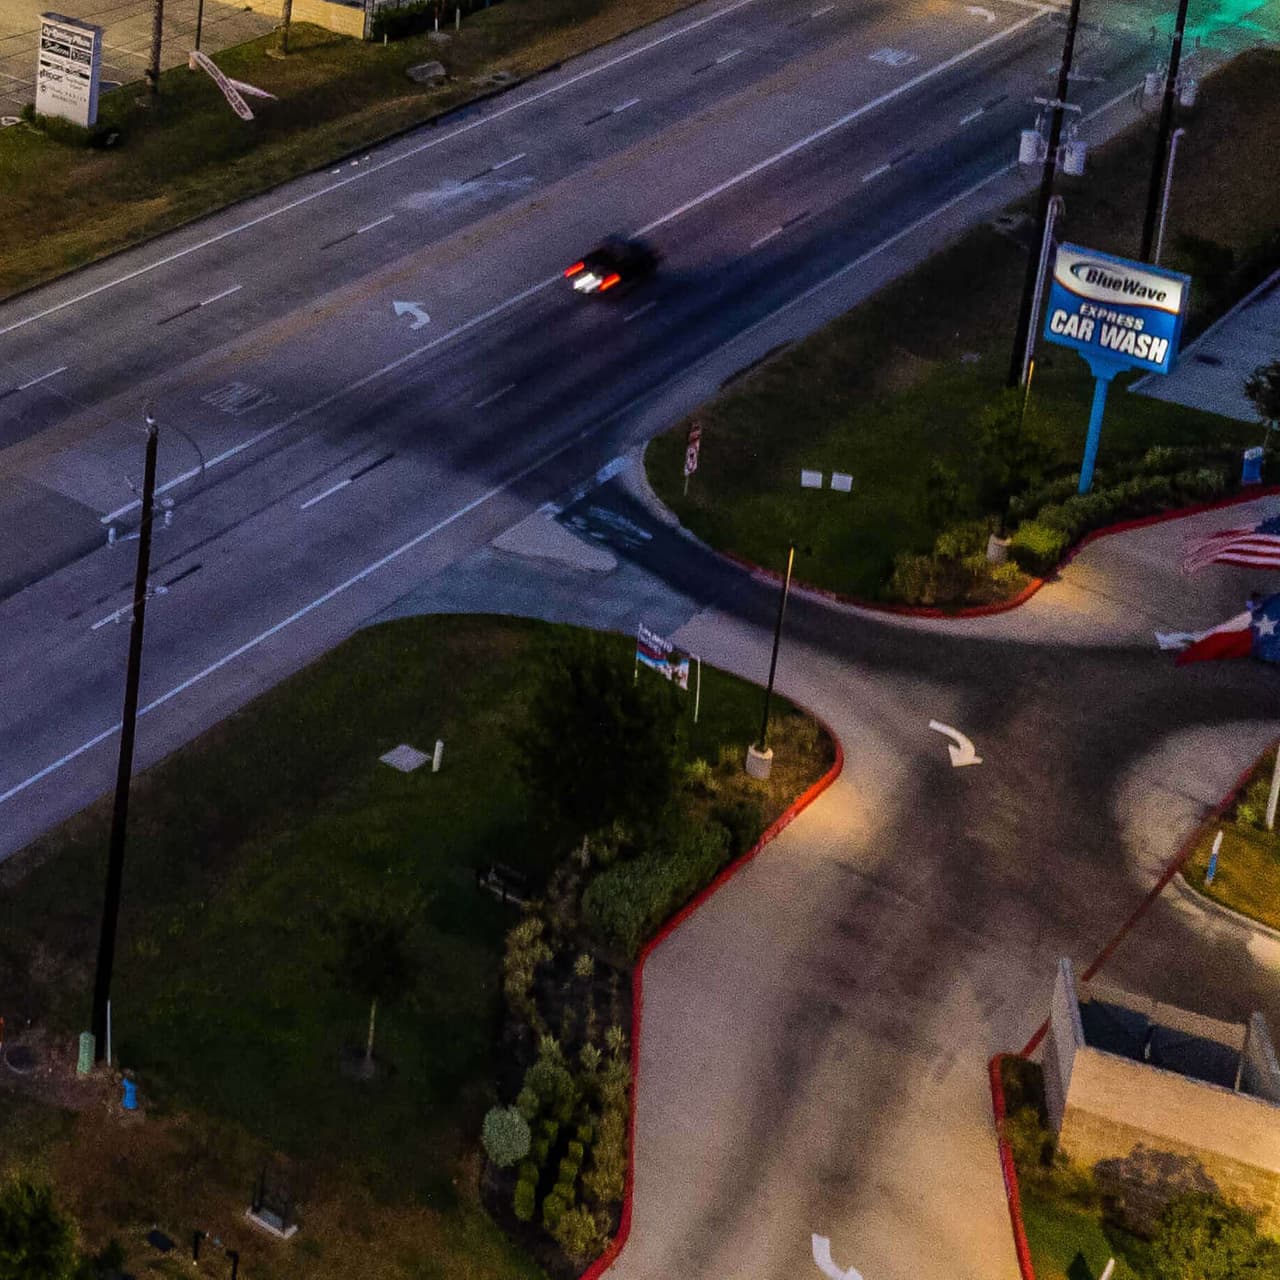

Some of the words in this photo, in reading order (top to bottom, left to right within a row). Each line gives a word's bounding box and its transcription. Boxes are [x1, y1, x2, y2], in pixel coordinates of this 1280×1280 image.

[1085, 270, 1167, 302] BlueWave
[1080, 302, 1144, 330] EXPRESS
[1050, 309, 1095, 342] CAR
[1100, 324, 1168, 364] WASH
